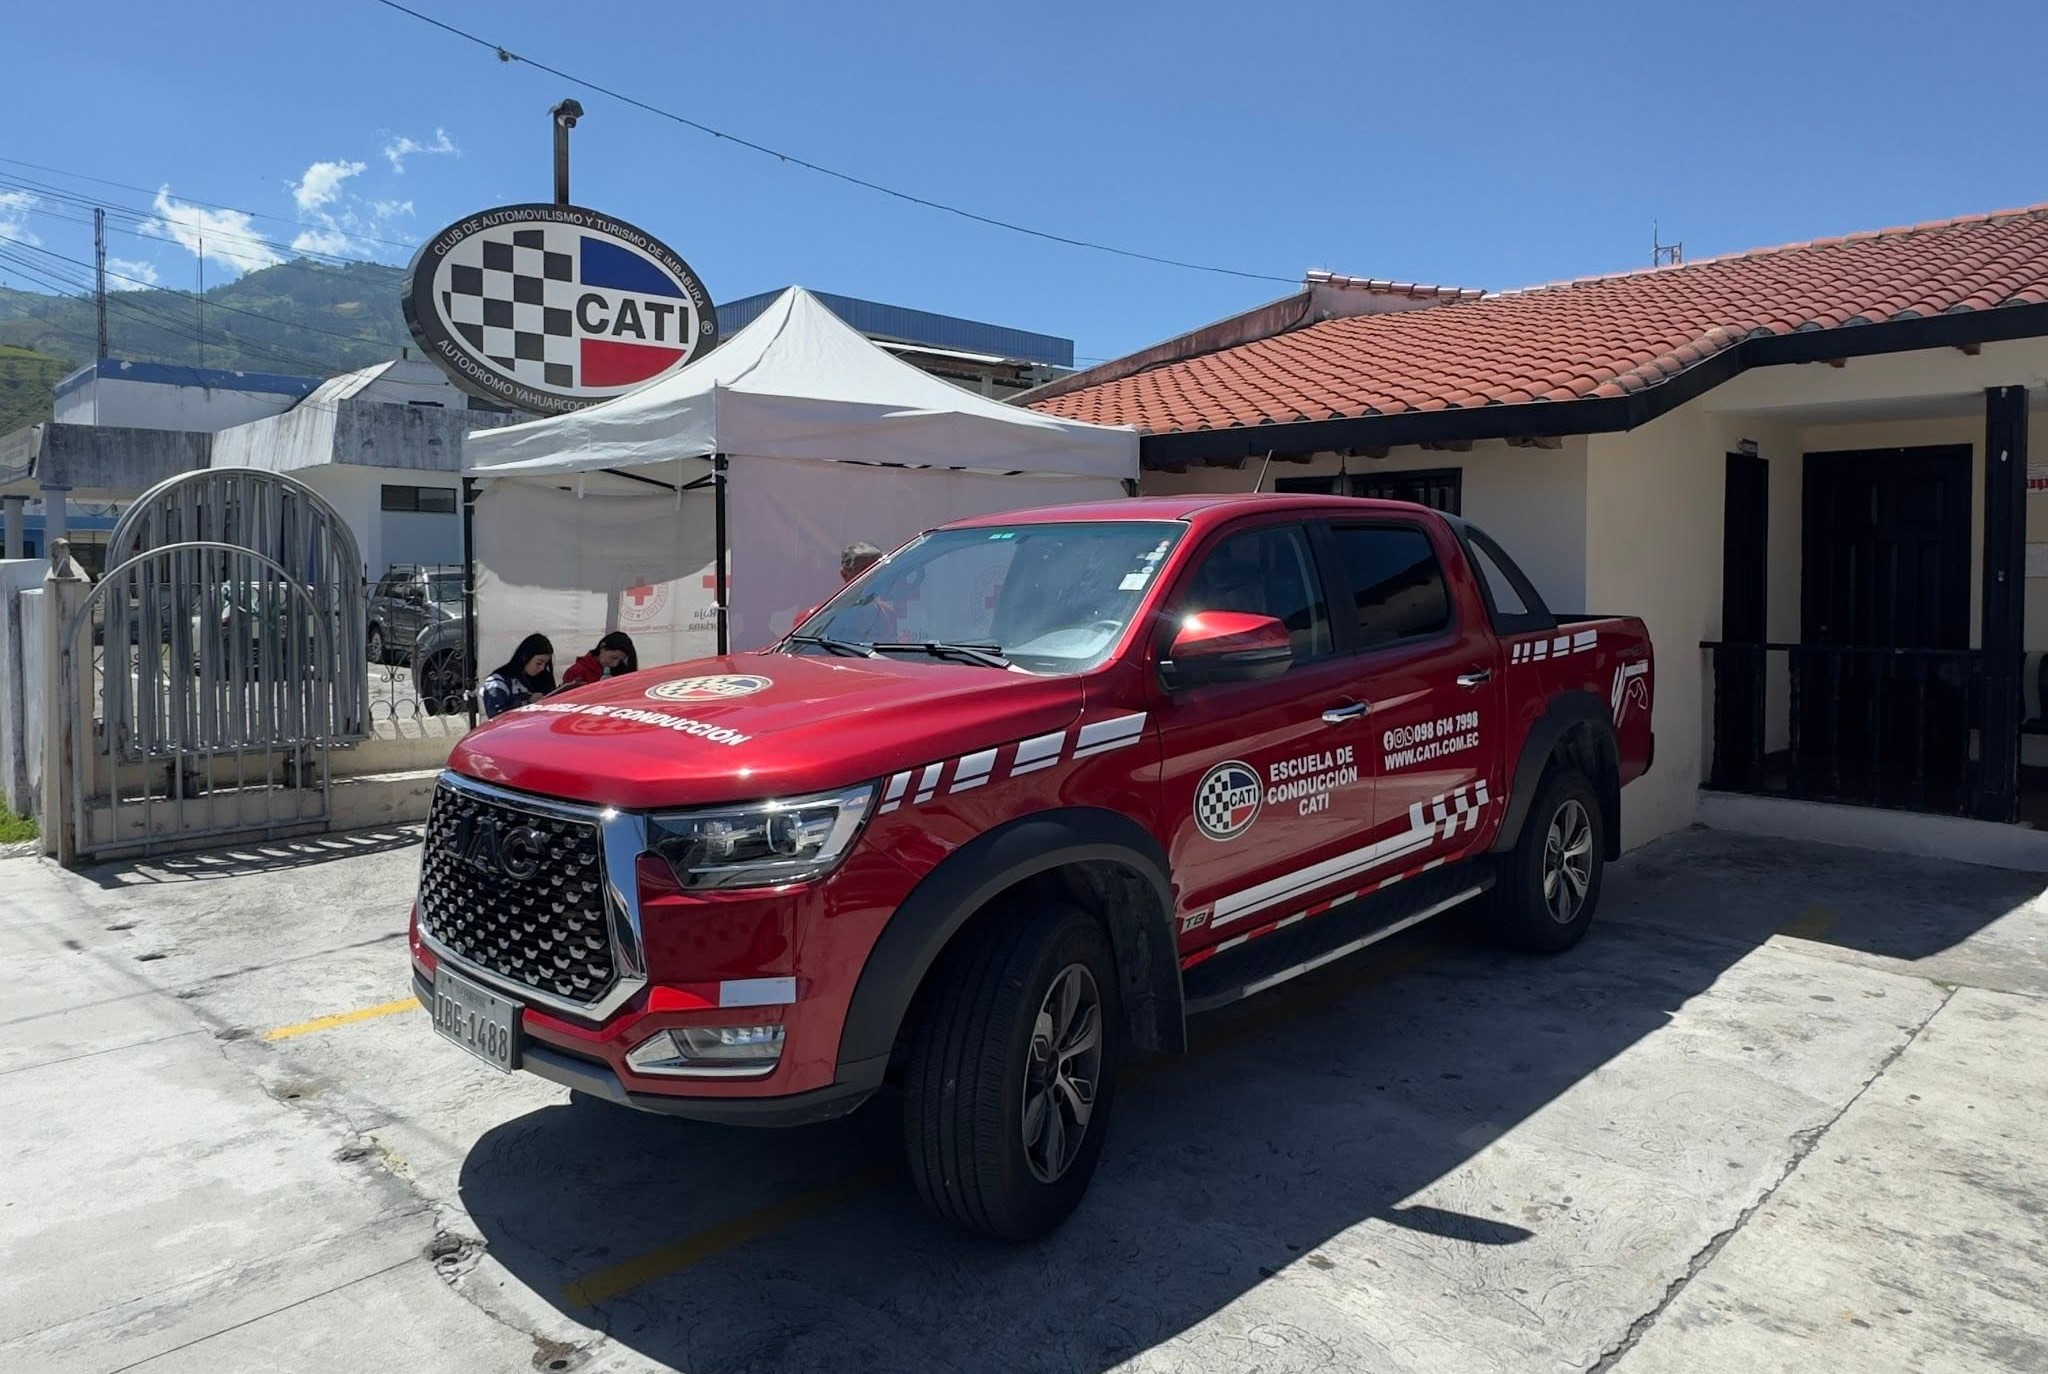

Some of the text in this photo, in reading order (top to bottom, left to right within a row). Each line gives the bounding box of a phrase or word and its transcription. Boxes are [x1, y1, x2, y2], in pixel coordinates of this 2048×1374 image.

[434, 208, 705, 309] CLUB DE AUTOMOVILISMO Y TURISMO DE IMBABURA
[575, 292, 690, 345] CATI
[437, 337, 601, 412] AUTODROMO YAHUARCOC
[580, 705, 620, 717] DE
[608, 708, 752, 747] CONDUCCIÓN
[1414, 710, 1479, 742] 098 614 7998
[1270, 746, 1354, 782] ESCUELA DE
[1384, 731, 1479, 771] WWW.CATI.COM.EC
[1230, 787, 1257, 807] CATI
[1267, 766, 1358, 805] CONDUCCIÓN
[1299, 793, 1330, 816] CATI
